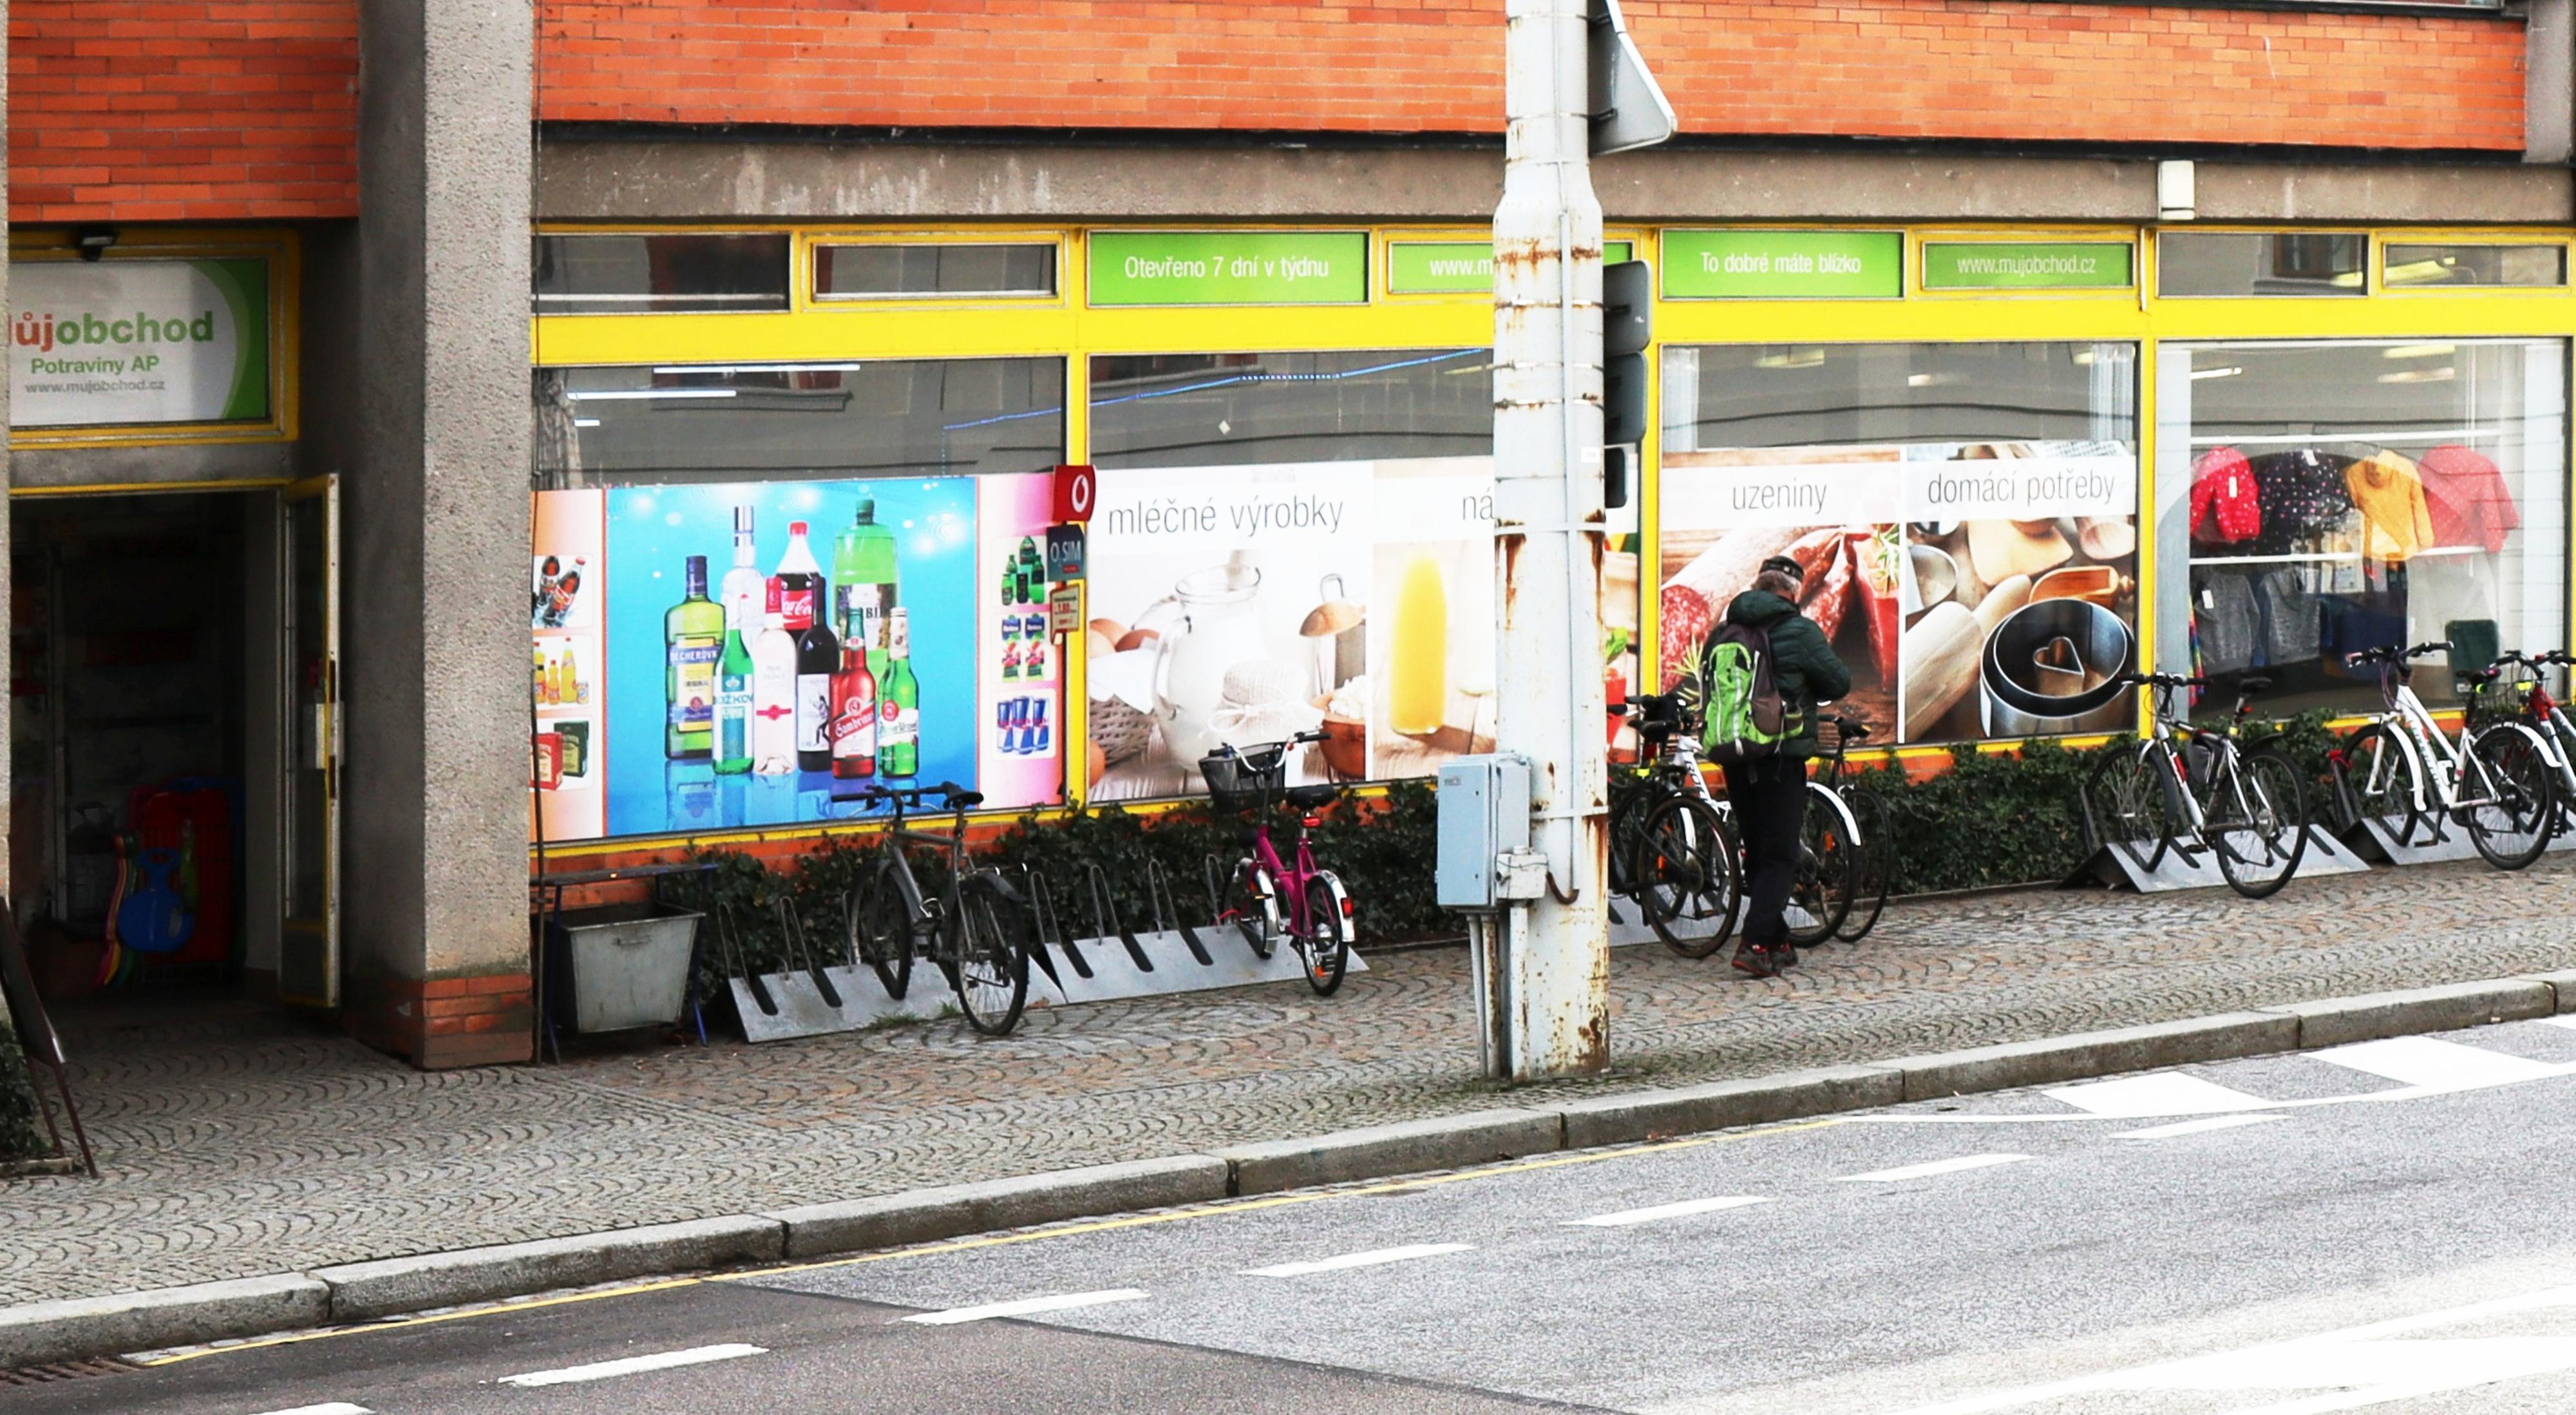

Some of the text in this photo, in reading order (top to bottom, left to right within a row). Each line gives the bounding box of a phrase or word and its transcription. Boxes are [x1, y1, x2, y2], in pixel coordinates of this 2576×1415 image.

[1124, 256, 1329, 281] Otevřeno 7 dní v týdnu
[1430, 258, 1493, 276] www.m
[1701, 252, 1861, 274] To dobré máte blízko
[1957, 254, 2096, 278] www.mujobchod.cz
[8, 310, 213, 352] ůjobchod
[32, 355, 160, 375] Potraviny AP
[25, 380, 166, 394] www.mujobchod.cz
[1732, 477, 1827, 514] uzeniny
[1927, 468, 2116, 506] domácí potřeby
[1109, 494, 1343, 537] mléčné výrobky
[1463, 487, 1495, 520] ná
[1062, 540, 1081, 562] SIM
